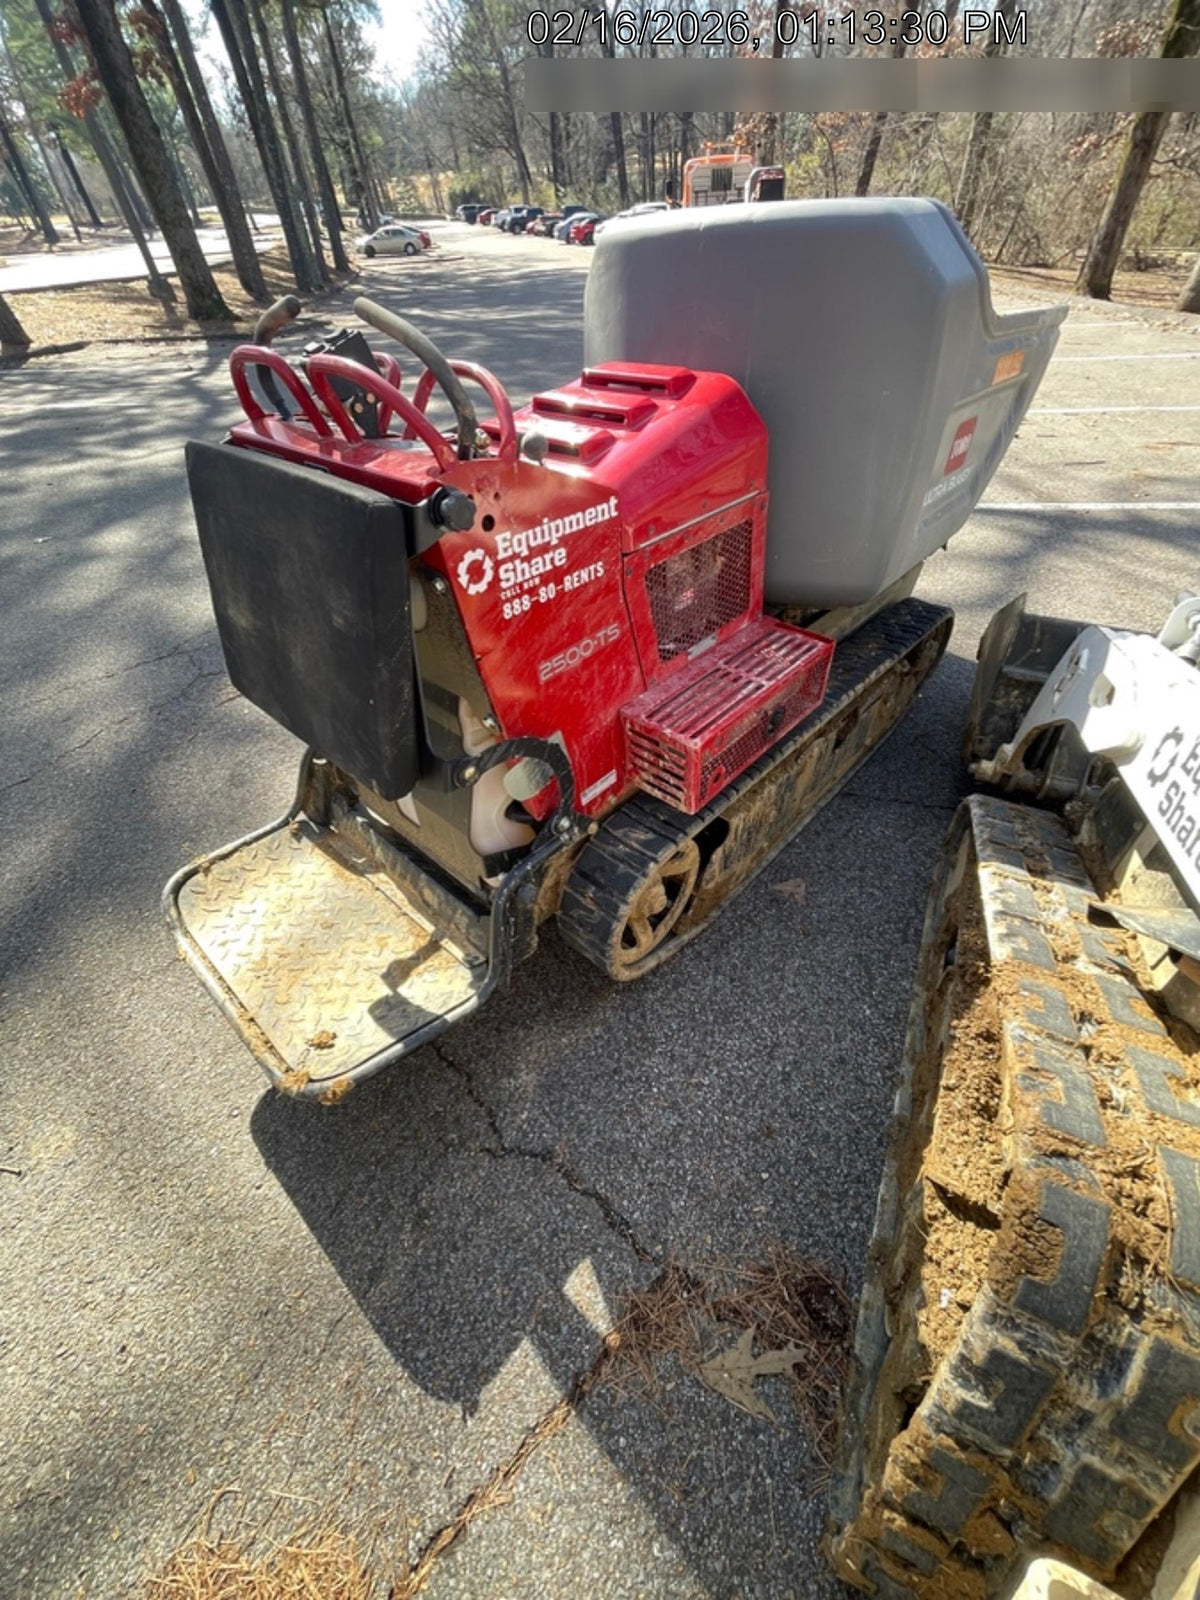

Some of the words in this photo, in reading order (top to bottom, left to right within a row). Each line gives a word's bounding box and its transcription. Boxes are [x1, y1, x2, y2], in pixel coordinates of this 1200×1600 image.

[495, 495, 619, 560] Equipment
[499, 546, 567, 590] Share
[502, 561, 605, 620] 888-80-RENTS
